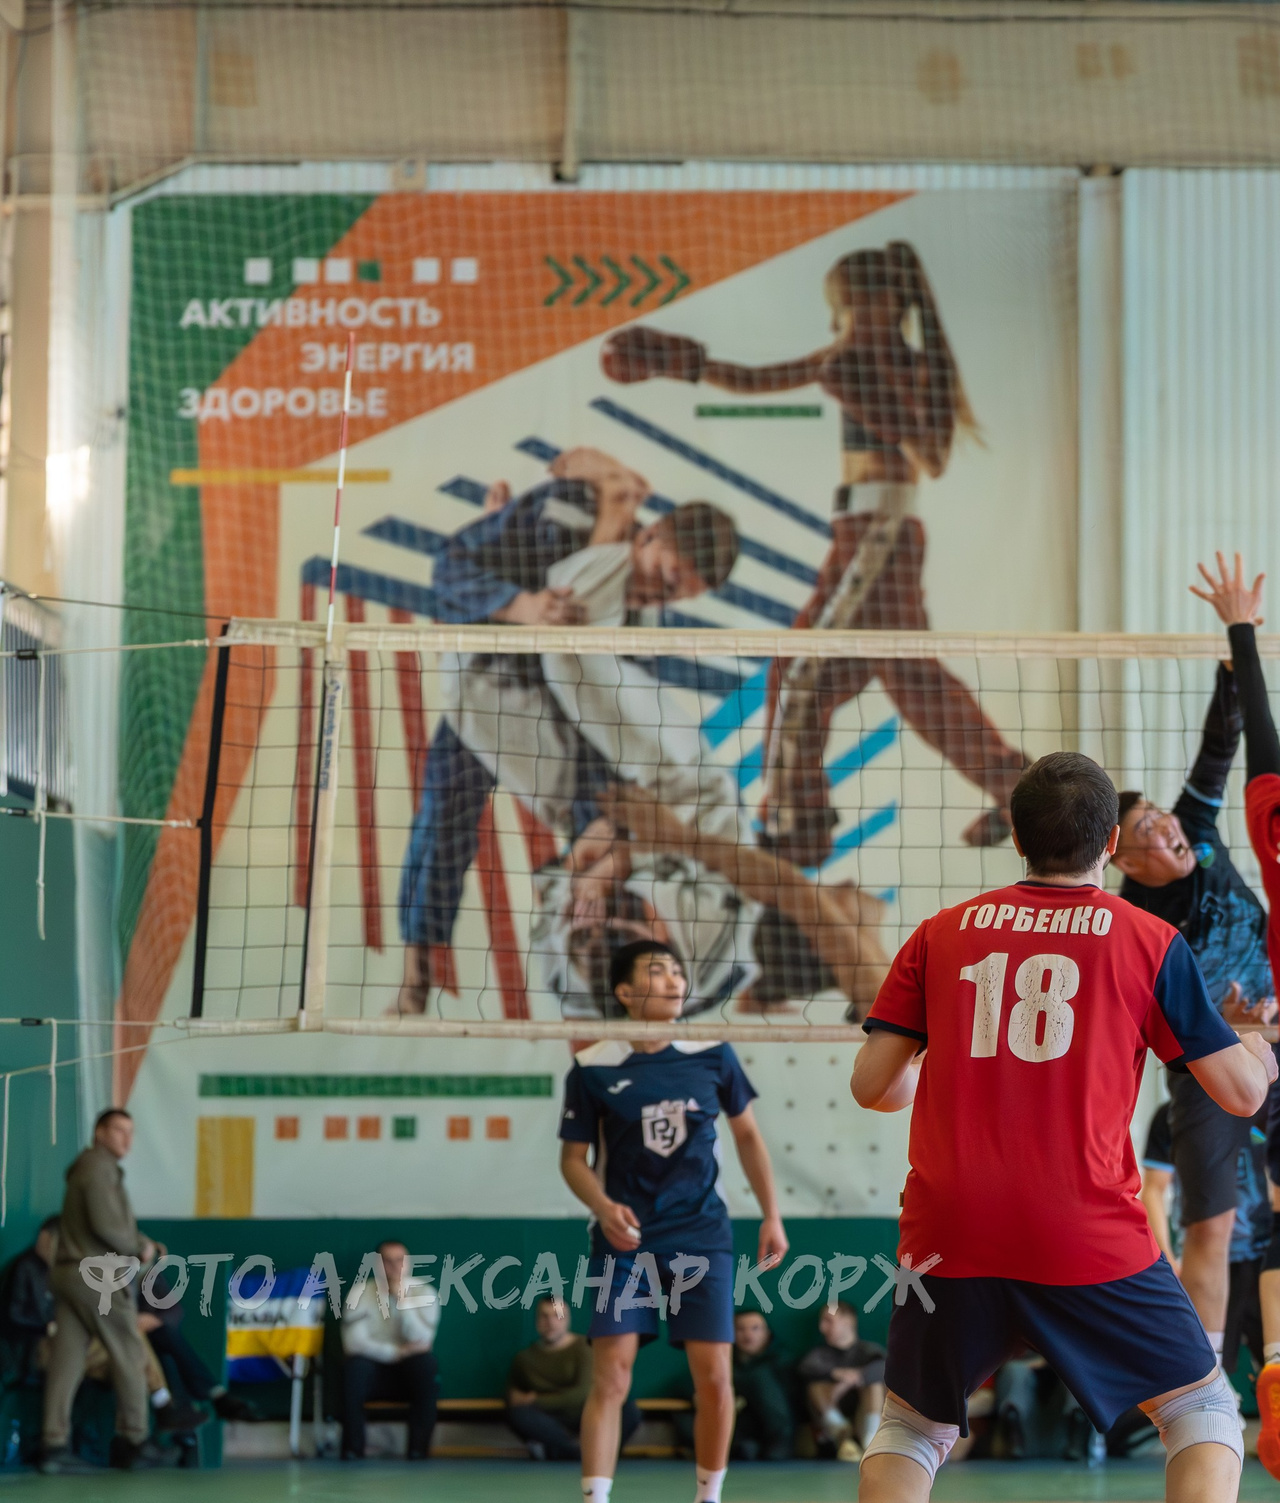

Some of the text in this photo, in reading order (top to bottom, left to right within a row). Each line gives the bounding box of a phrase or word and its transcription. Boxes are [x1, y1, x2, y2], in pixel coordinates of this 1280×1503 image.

[179, 297, 442, 328] АКТИВНОСТЬ
[301, 342, 475, 372] ЭНЕРГИЯ
[178, 387, 388, 423] ЗДОРОВЬЕ
[959, 903, 1113, 936] ГОРБЕНКО
[959, 952, 1080, 1063] 18
